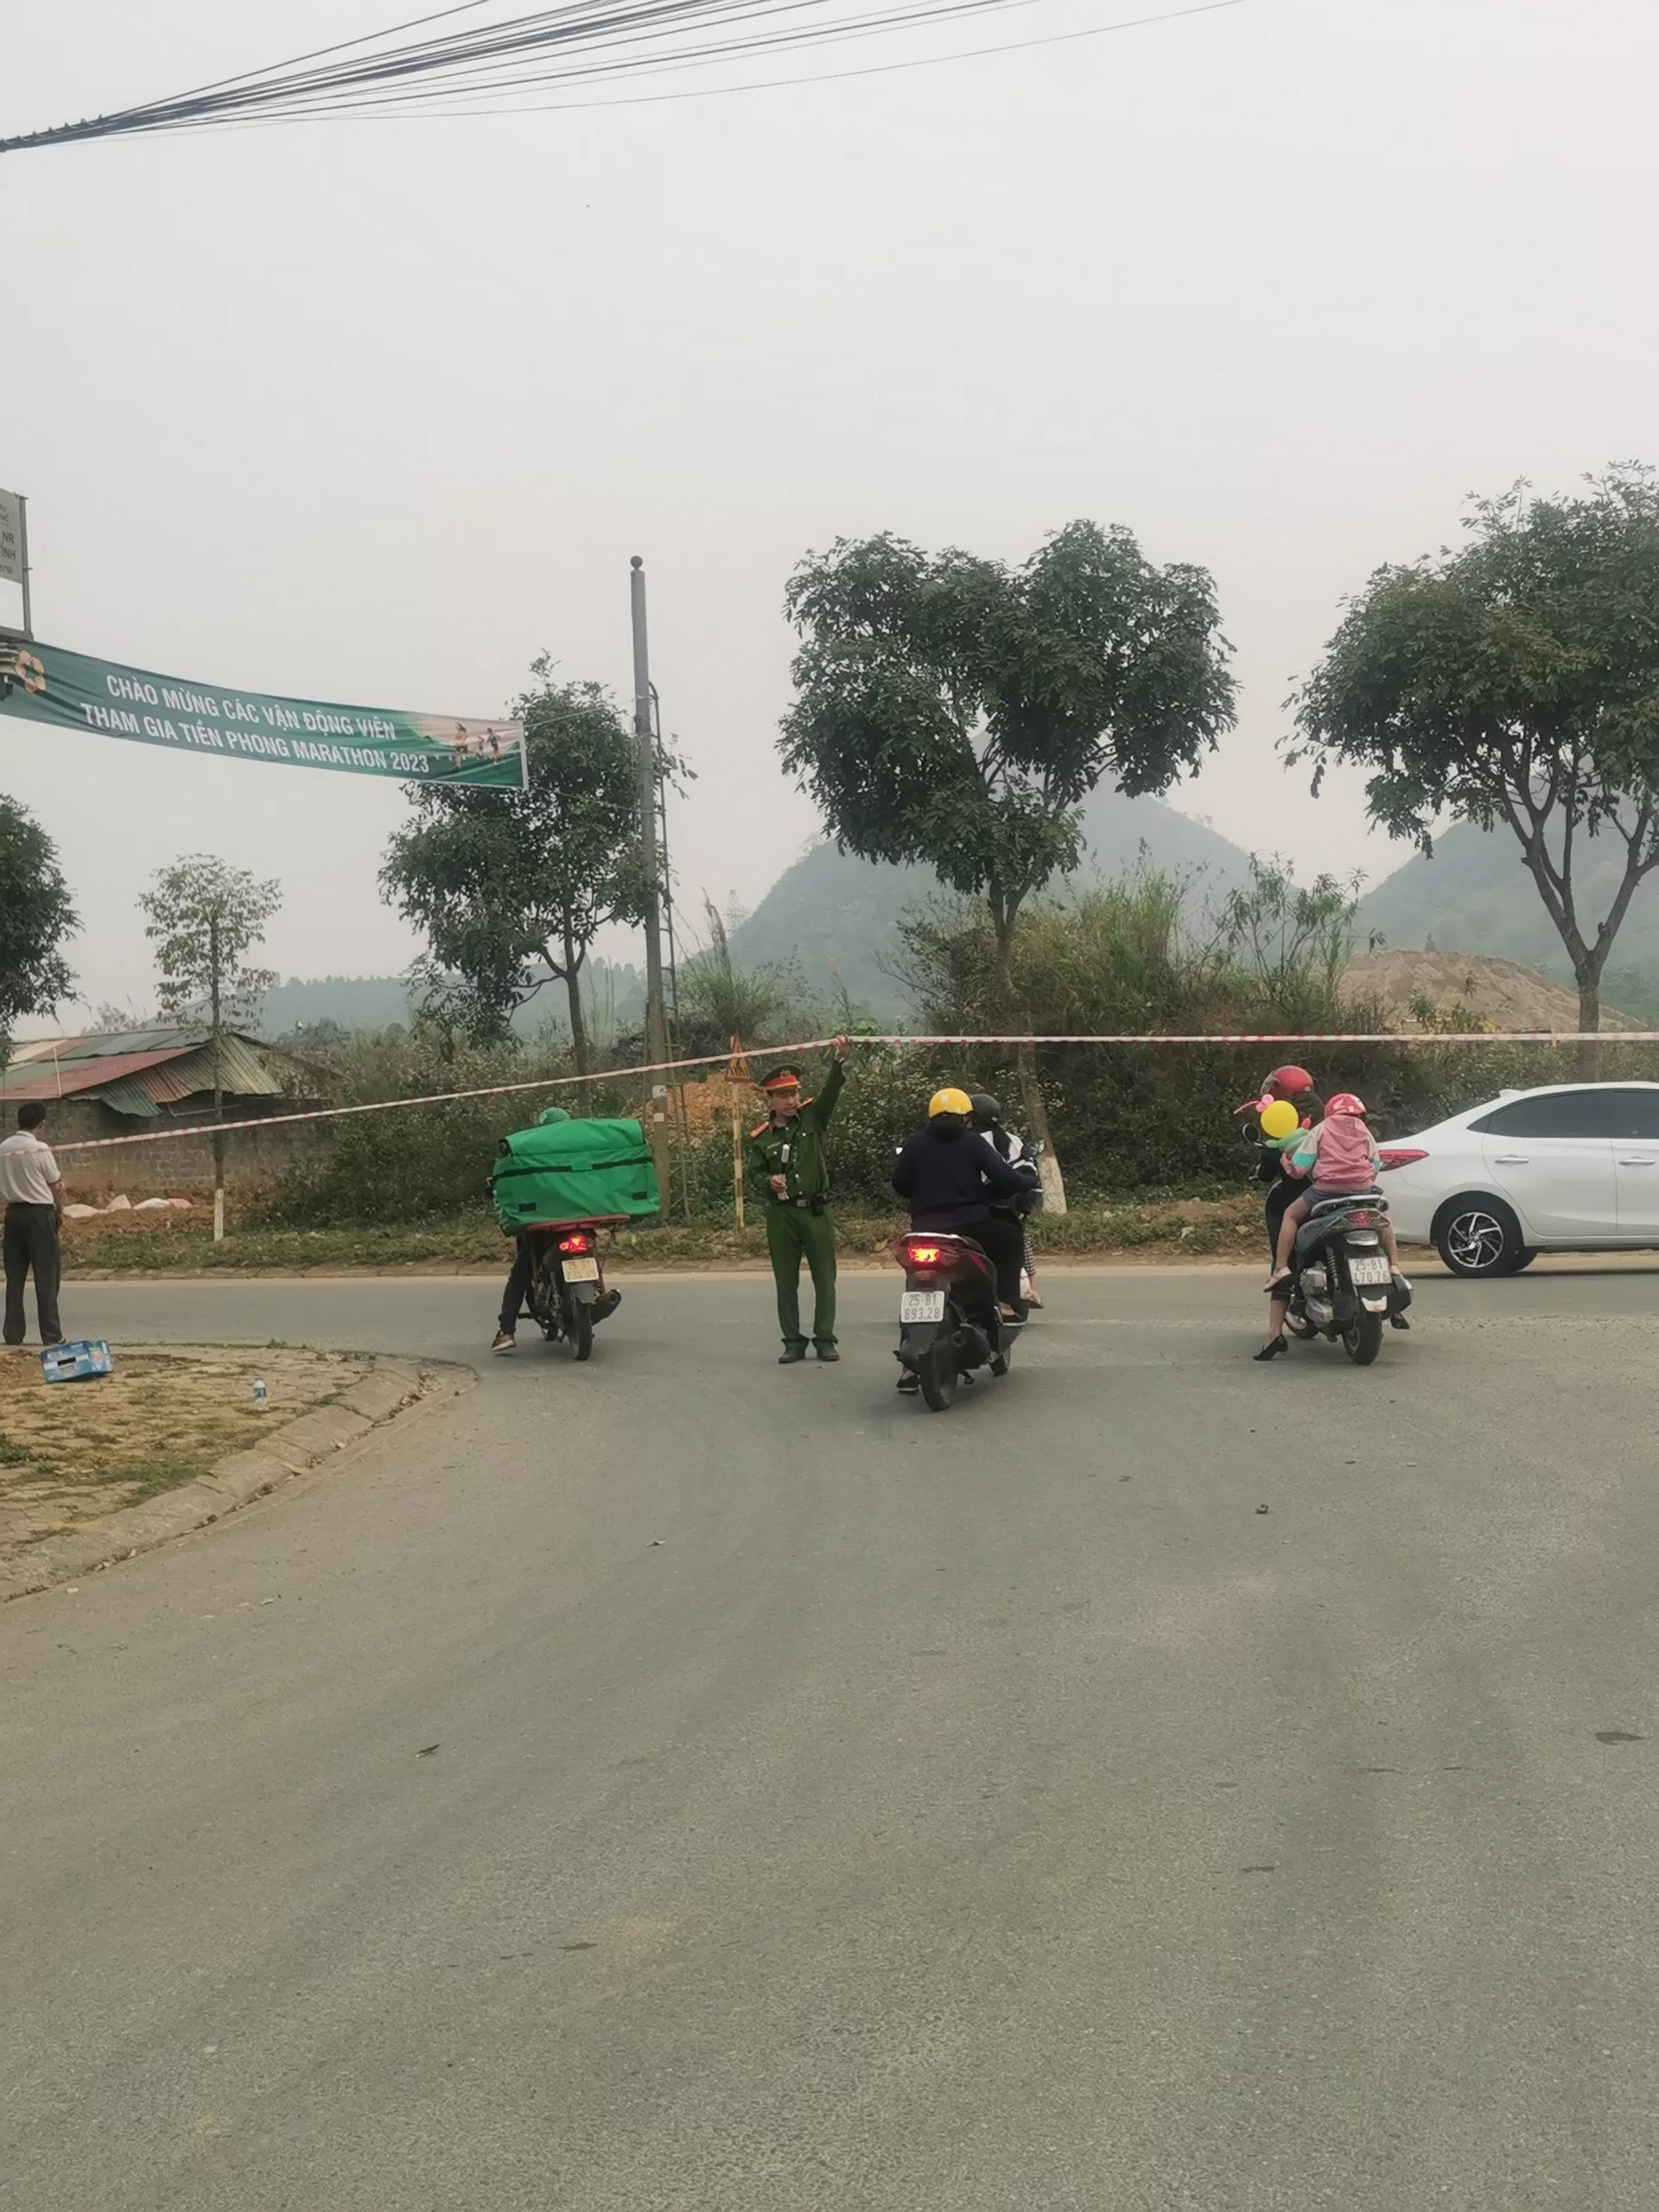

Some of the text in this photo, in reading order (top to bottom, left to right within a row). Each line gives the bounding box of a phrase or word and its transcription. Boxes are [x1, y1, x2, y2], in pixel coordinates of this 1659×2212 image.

[79, 702, 141, 734] THAM
[144, 715, 179, 741] GIA
[226, 730, 291, 758] PHONG
[291, 740, 388, 769] MARATHON
[390, 752, 430, 773] 2023
[105, 675, 397, 741] CHÀO MỪNG CÁC VẬN ĐỘNG VIÊN
